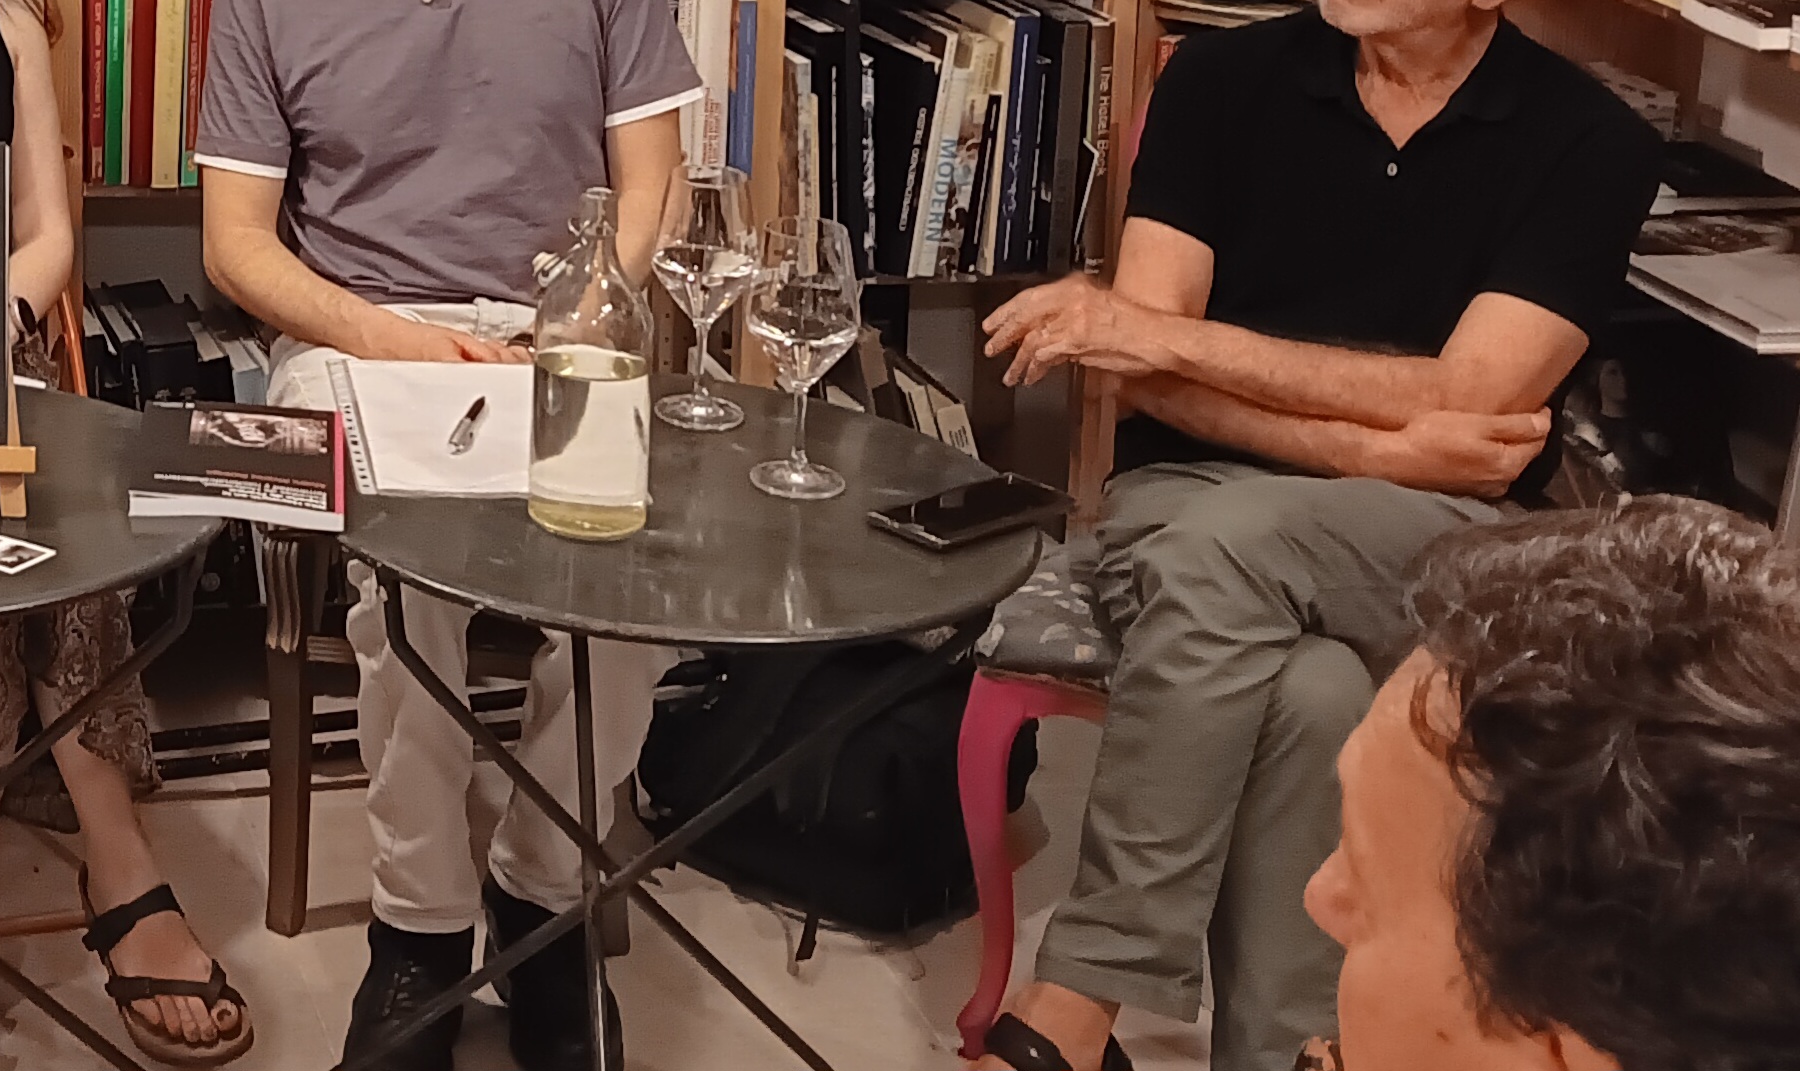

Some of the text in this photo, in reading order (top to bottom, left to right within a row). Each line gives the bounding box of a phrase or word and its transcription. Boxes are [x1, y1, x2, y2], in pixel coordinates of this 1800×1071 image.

[1093, 64, 1113, 176] The Hotel Book
[926, 139, 957, 242] MODERN
